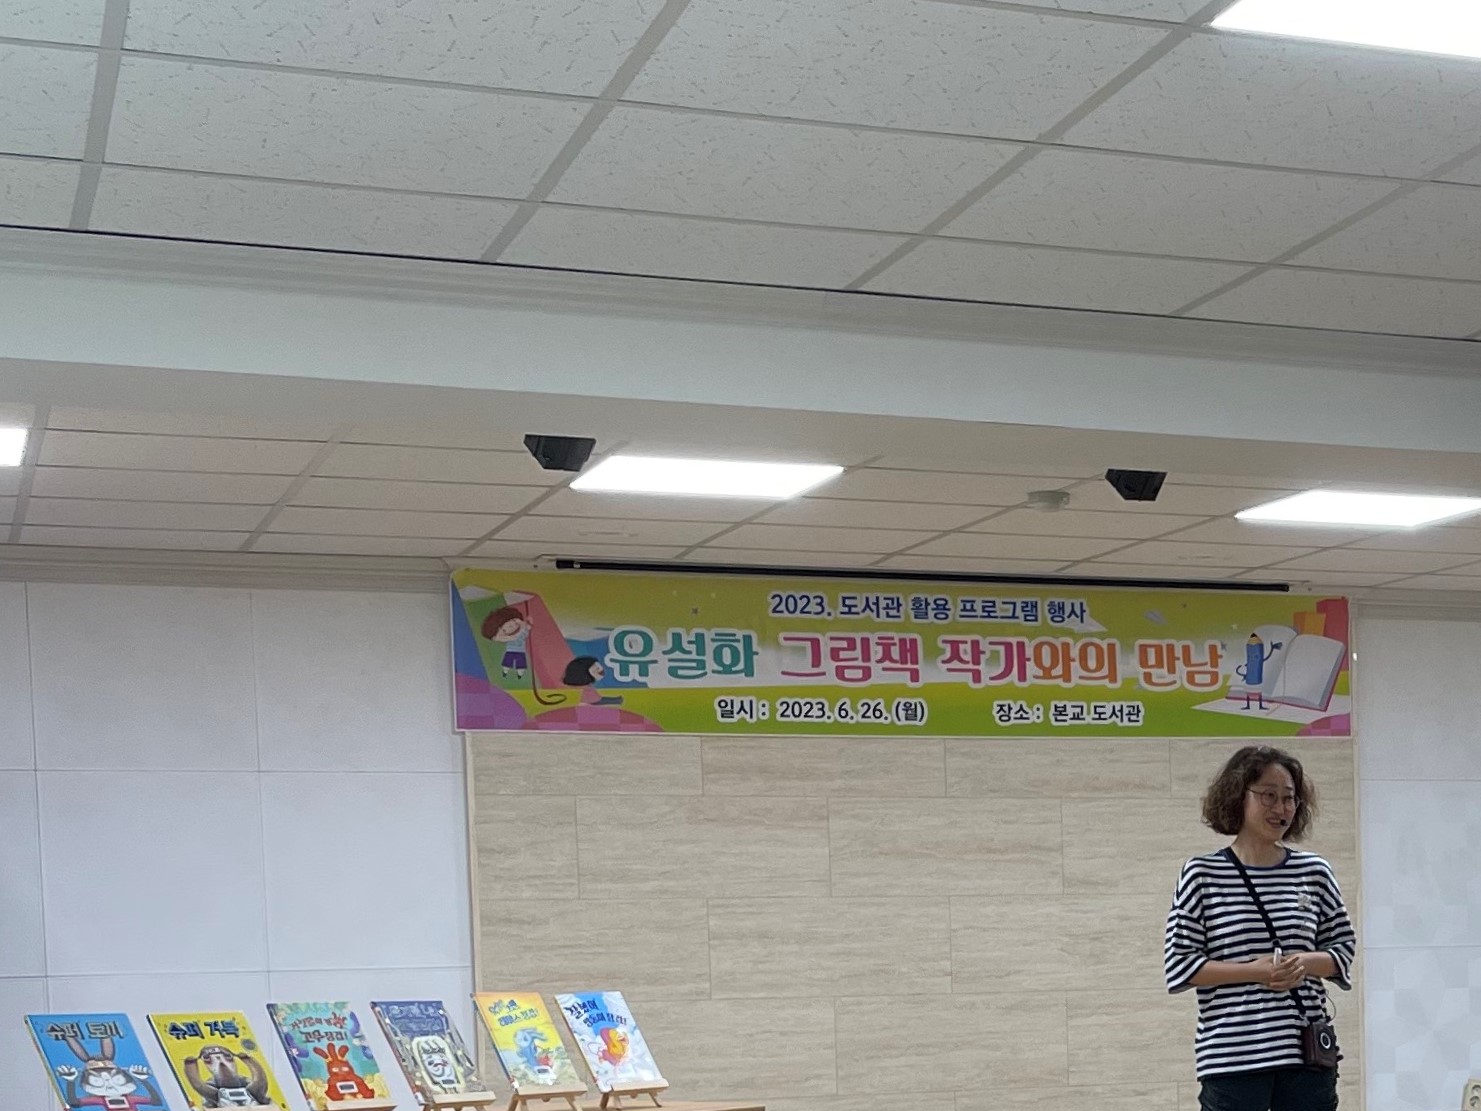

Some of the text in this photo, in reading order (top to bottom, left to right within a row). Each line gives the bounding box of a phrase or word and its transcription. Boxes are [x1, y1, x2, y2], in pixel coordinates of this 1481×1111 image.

[770, 595, 1087, 623] 2023. 도서관 활용 프로그램 행사
[610, 629, 1223, 688] 유설화 그림책 작가와의 만남
[1052, 704, 1085, 723] 본교
[1092, 704, 1142, 724] 도서관
[46, 1020, 125, 1041] 슈퍼 토끼
[168, 1017, 240, 1040] 슈퍼 거북
